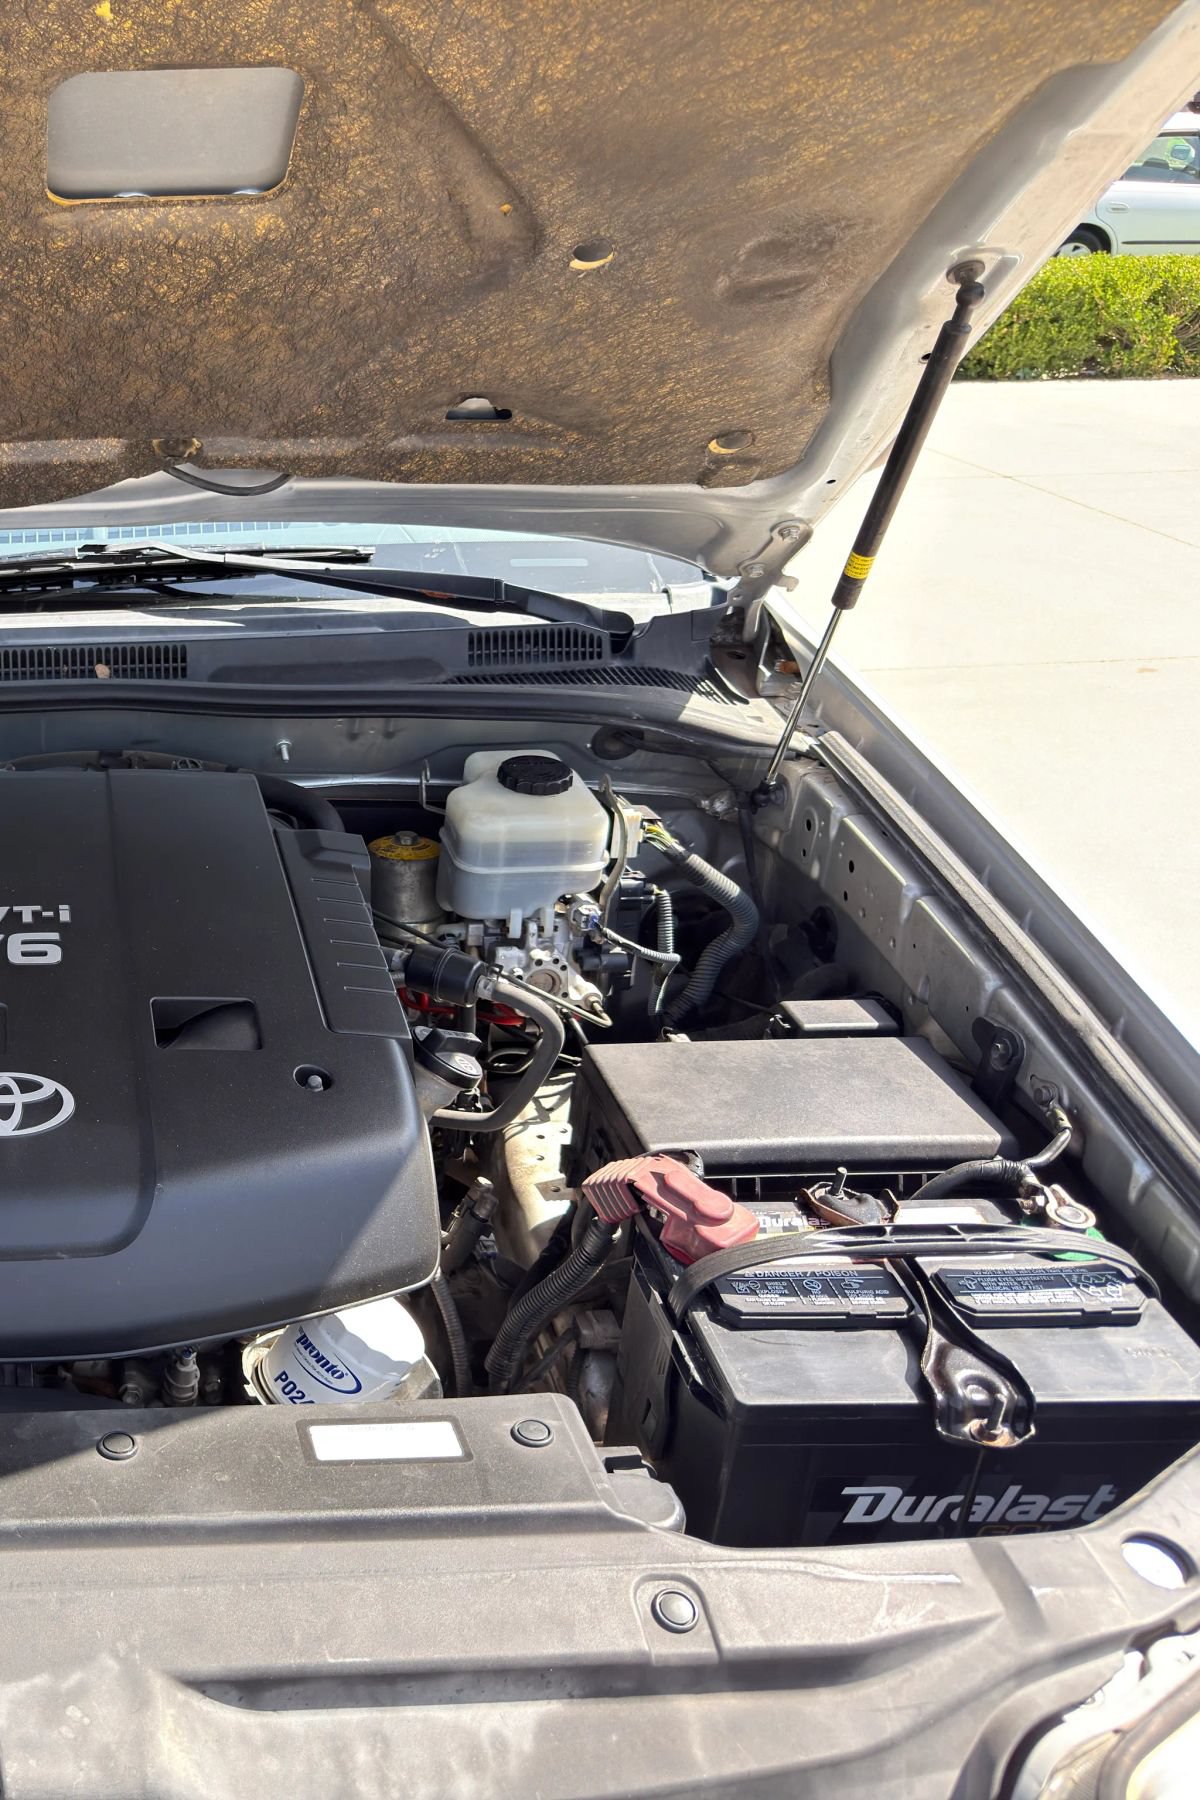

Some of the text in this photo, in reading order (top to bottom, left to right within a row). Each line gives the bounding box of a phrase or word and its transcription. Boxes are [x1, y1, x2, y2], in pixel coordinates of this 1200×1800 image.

[760, 1216, 831, 1227] Duralas
[295, 1332, 345, 1379] pronto
[841, 1485, 1117, 1523] Duralast
